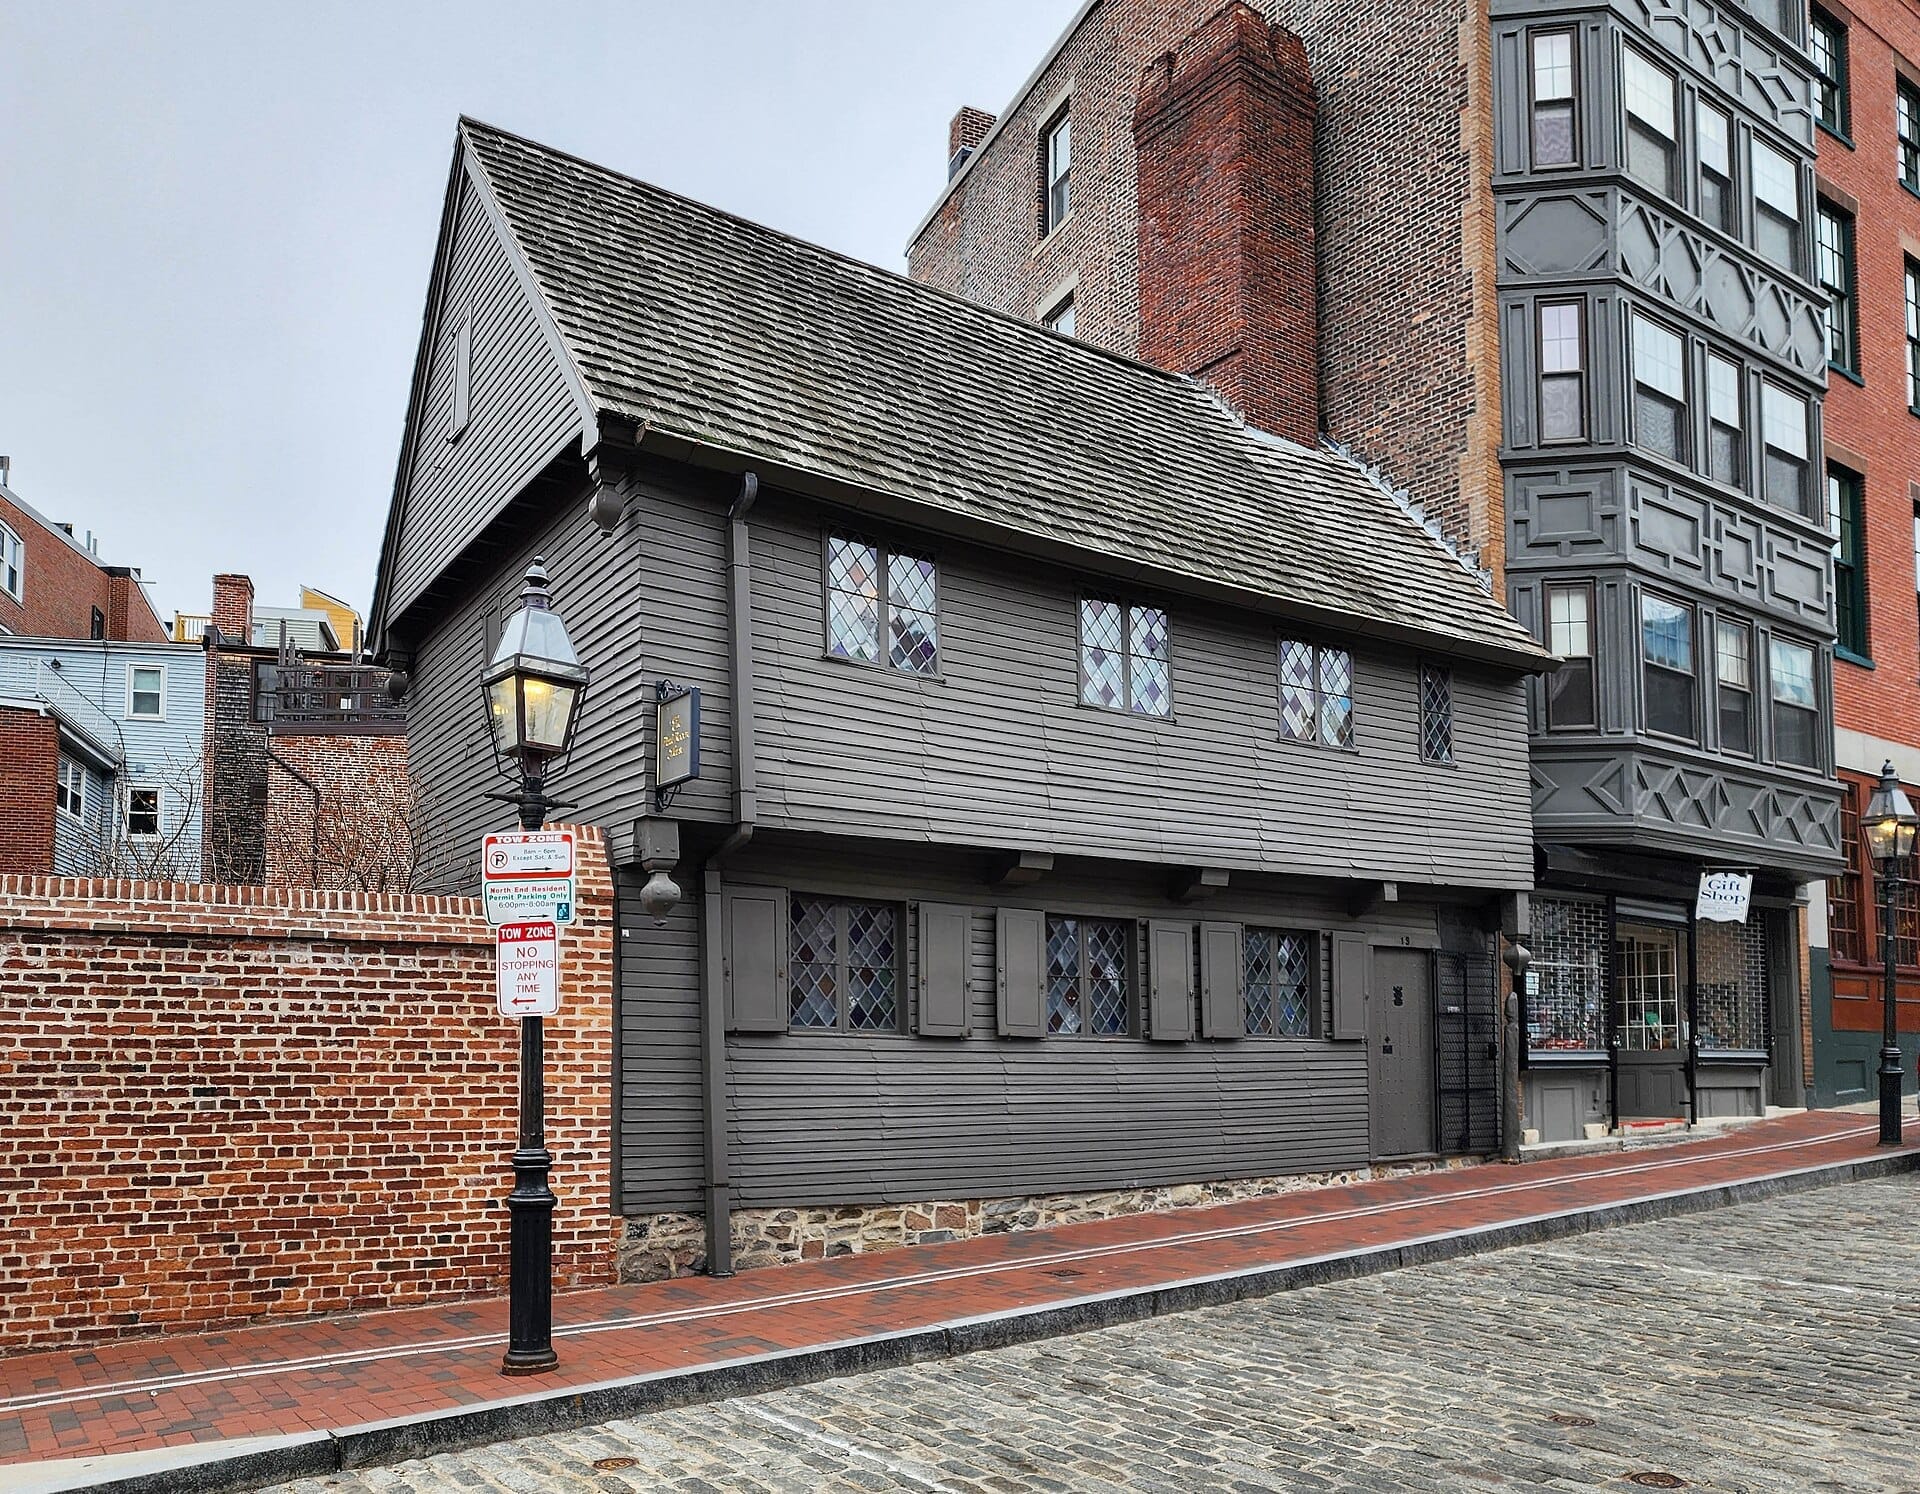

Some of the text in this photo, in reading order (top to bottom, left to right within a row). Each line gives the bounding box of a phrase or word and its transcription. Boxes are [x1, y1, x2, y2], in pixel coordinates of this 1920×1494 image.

[495, 835, 562, 844] TOW ZONE
[490, 886, 511, 894] North
[532, 885, 566, 893] Resident
[1708, 879, 1740, 890] Gift
[489, 892, 568, 901] Permit Parking Only
[1701, 891, 1745, 904] Shop
[500, 926, 554, 940] TOW ZONE
[516, 946, 538, 958] NO
[502, 960, 554, 970] STOPPING
[516, 972, 538, 982] ANY
[515, 983, 541, 993] TIME
